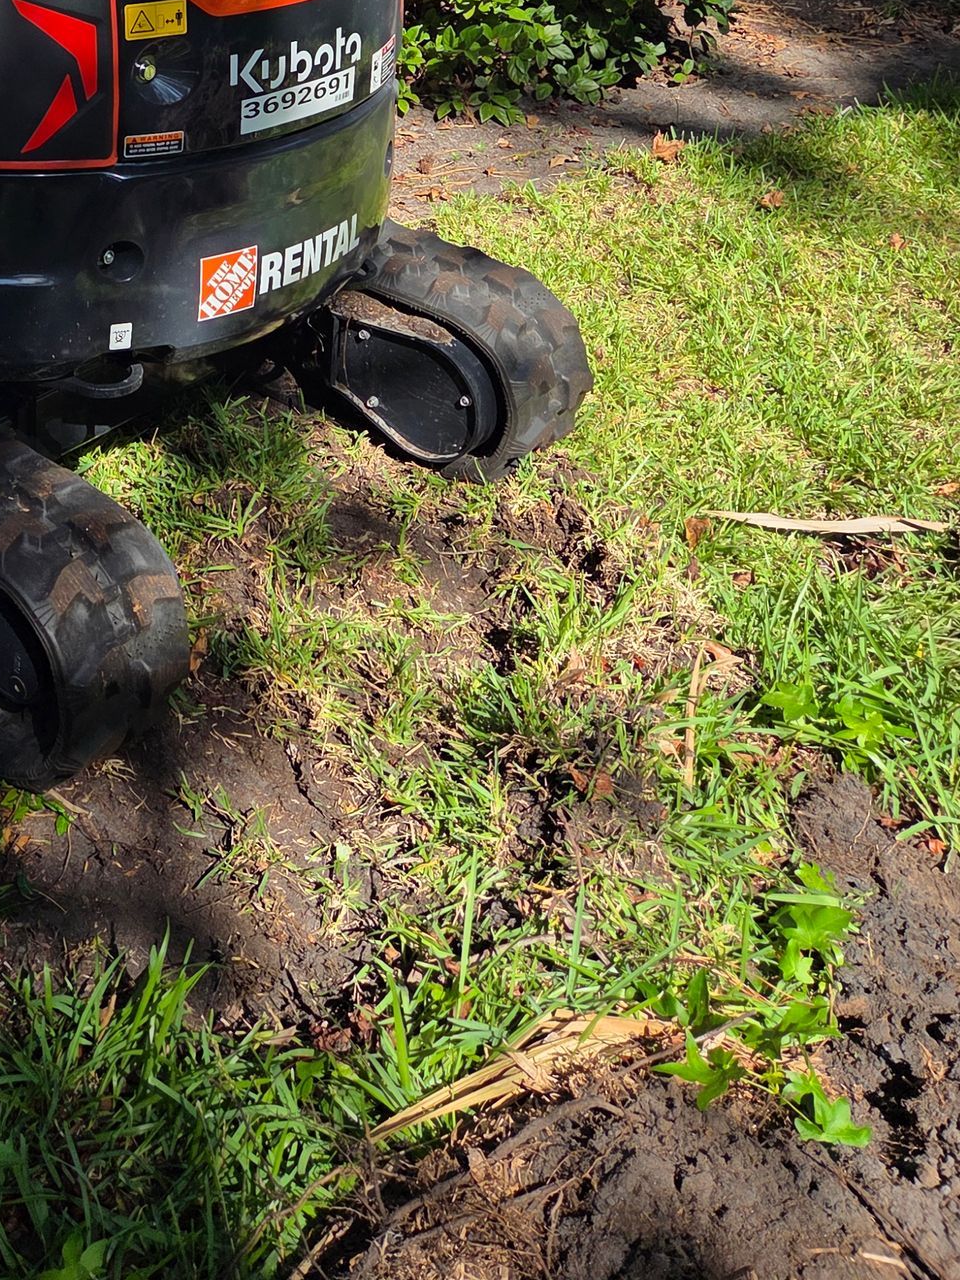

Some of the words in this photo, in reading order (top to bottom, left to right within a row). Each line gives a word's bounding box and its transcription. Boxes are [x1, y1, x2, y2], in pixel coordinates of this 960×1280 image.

[229, 26, 362, 94] Kubota
[243, 72, 350, 120] 3692691
[140, 133, 179, 141] WARNING
[206, 260, 232, 289] THE
[259, 213, 360, 295] RENTAL
[200, 249, 258, 317] HOME
[222, 270, 256, 314] DEPOT
